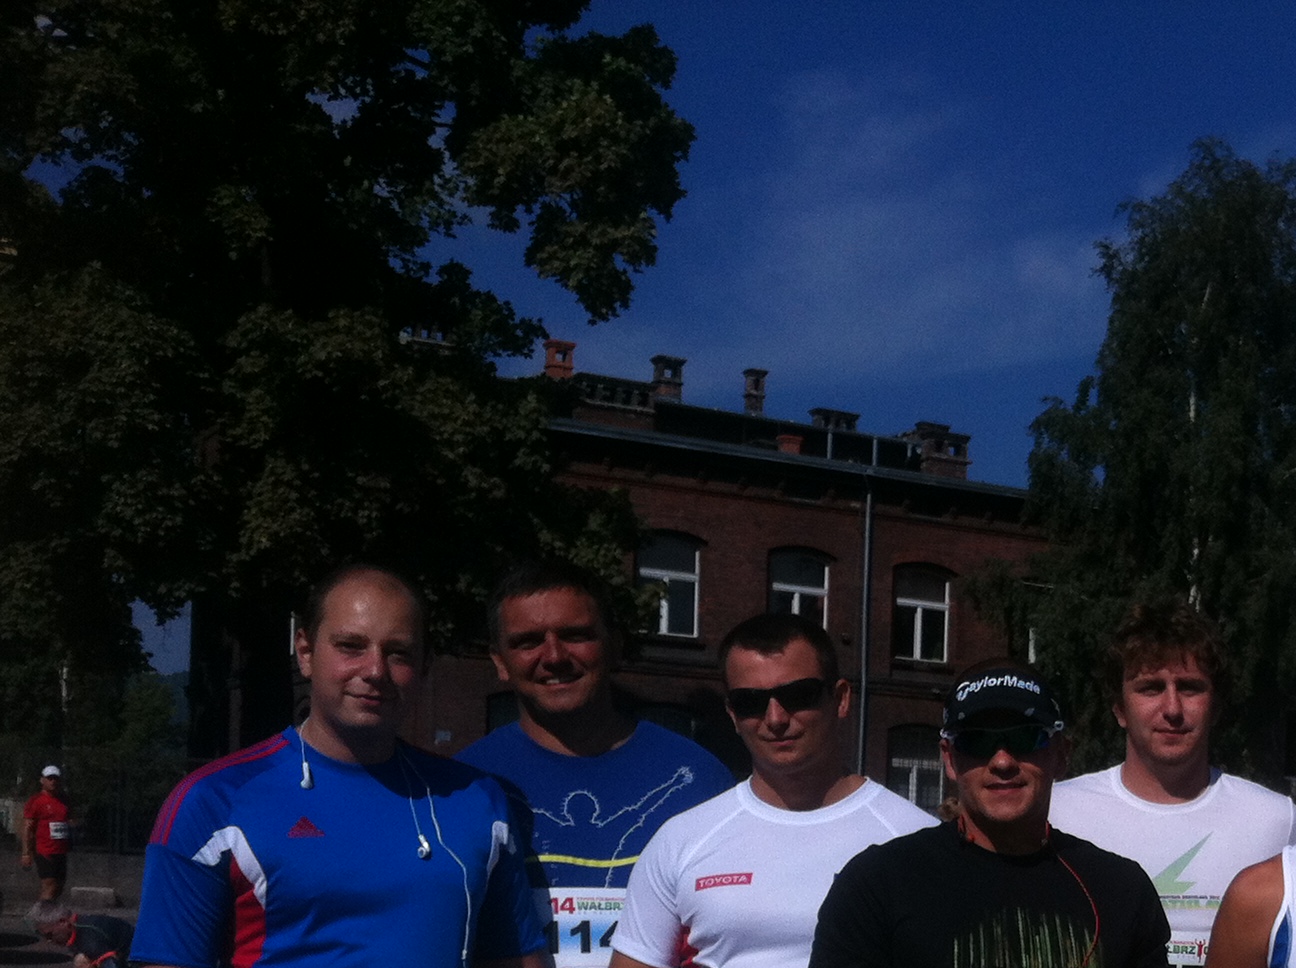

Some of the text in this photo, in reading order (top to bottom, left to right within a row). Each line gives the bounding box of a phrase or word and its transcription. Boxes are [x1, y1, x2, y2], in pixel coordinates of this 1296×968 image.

[956, 675, 1041, 701] TaylorMade
[698, 873, 748, 888] TOYOTA
[549, 897, 576, 915] 14
[577, 901, 625, 911] WAŁBR
